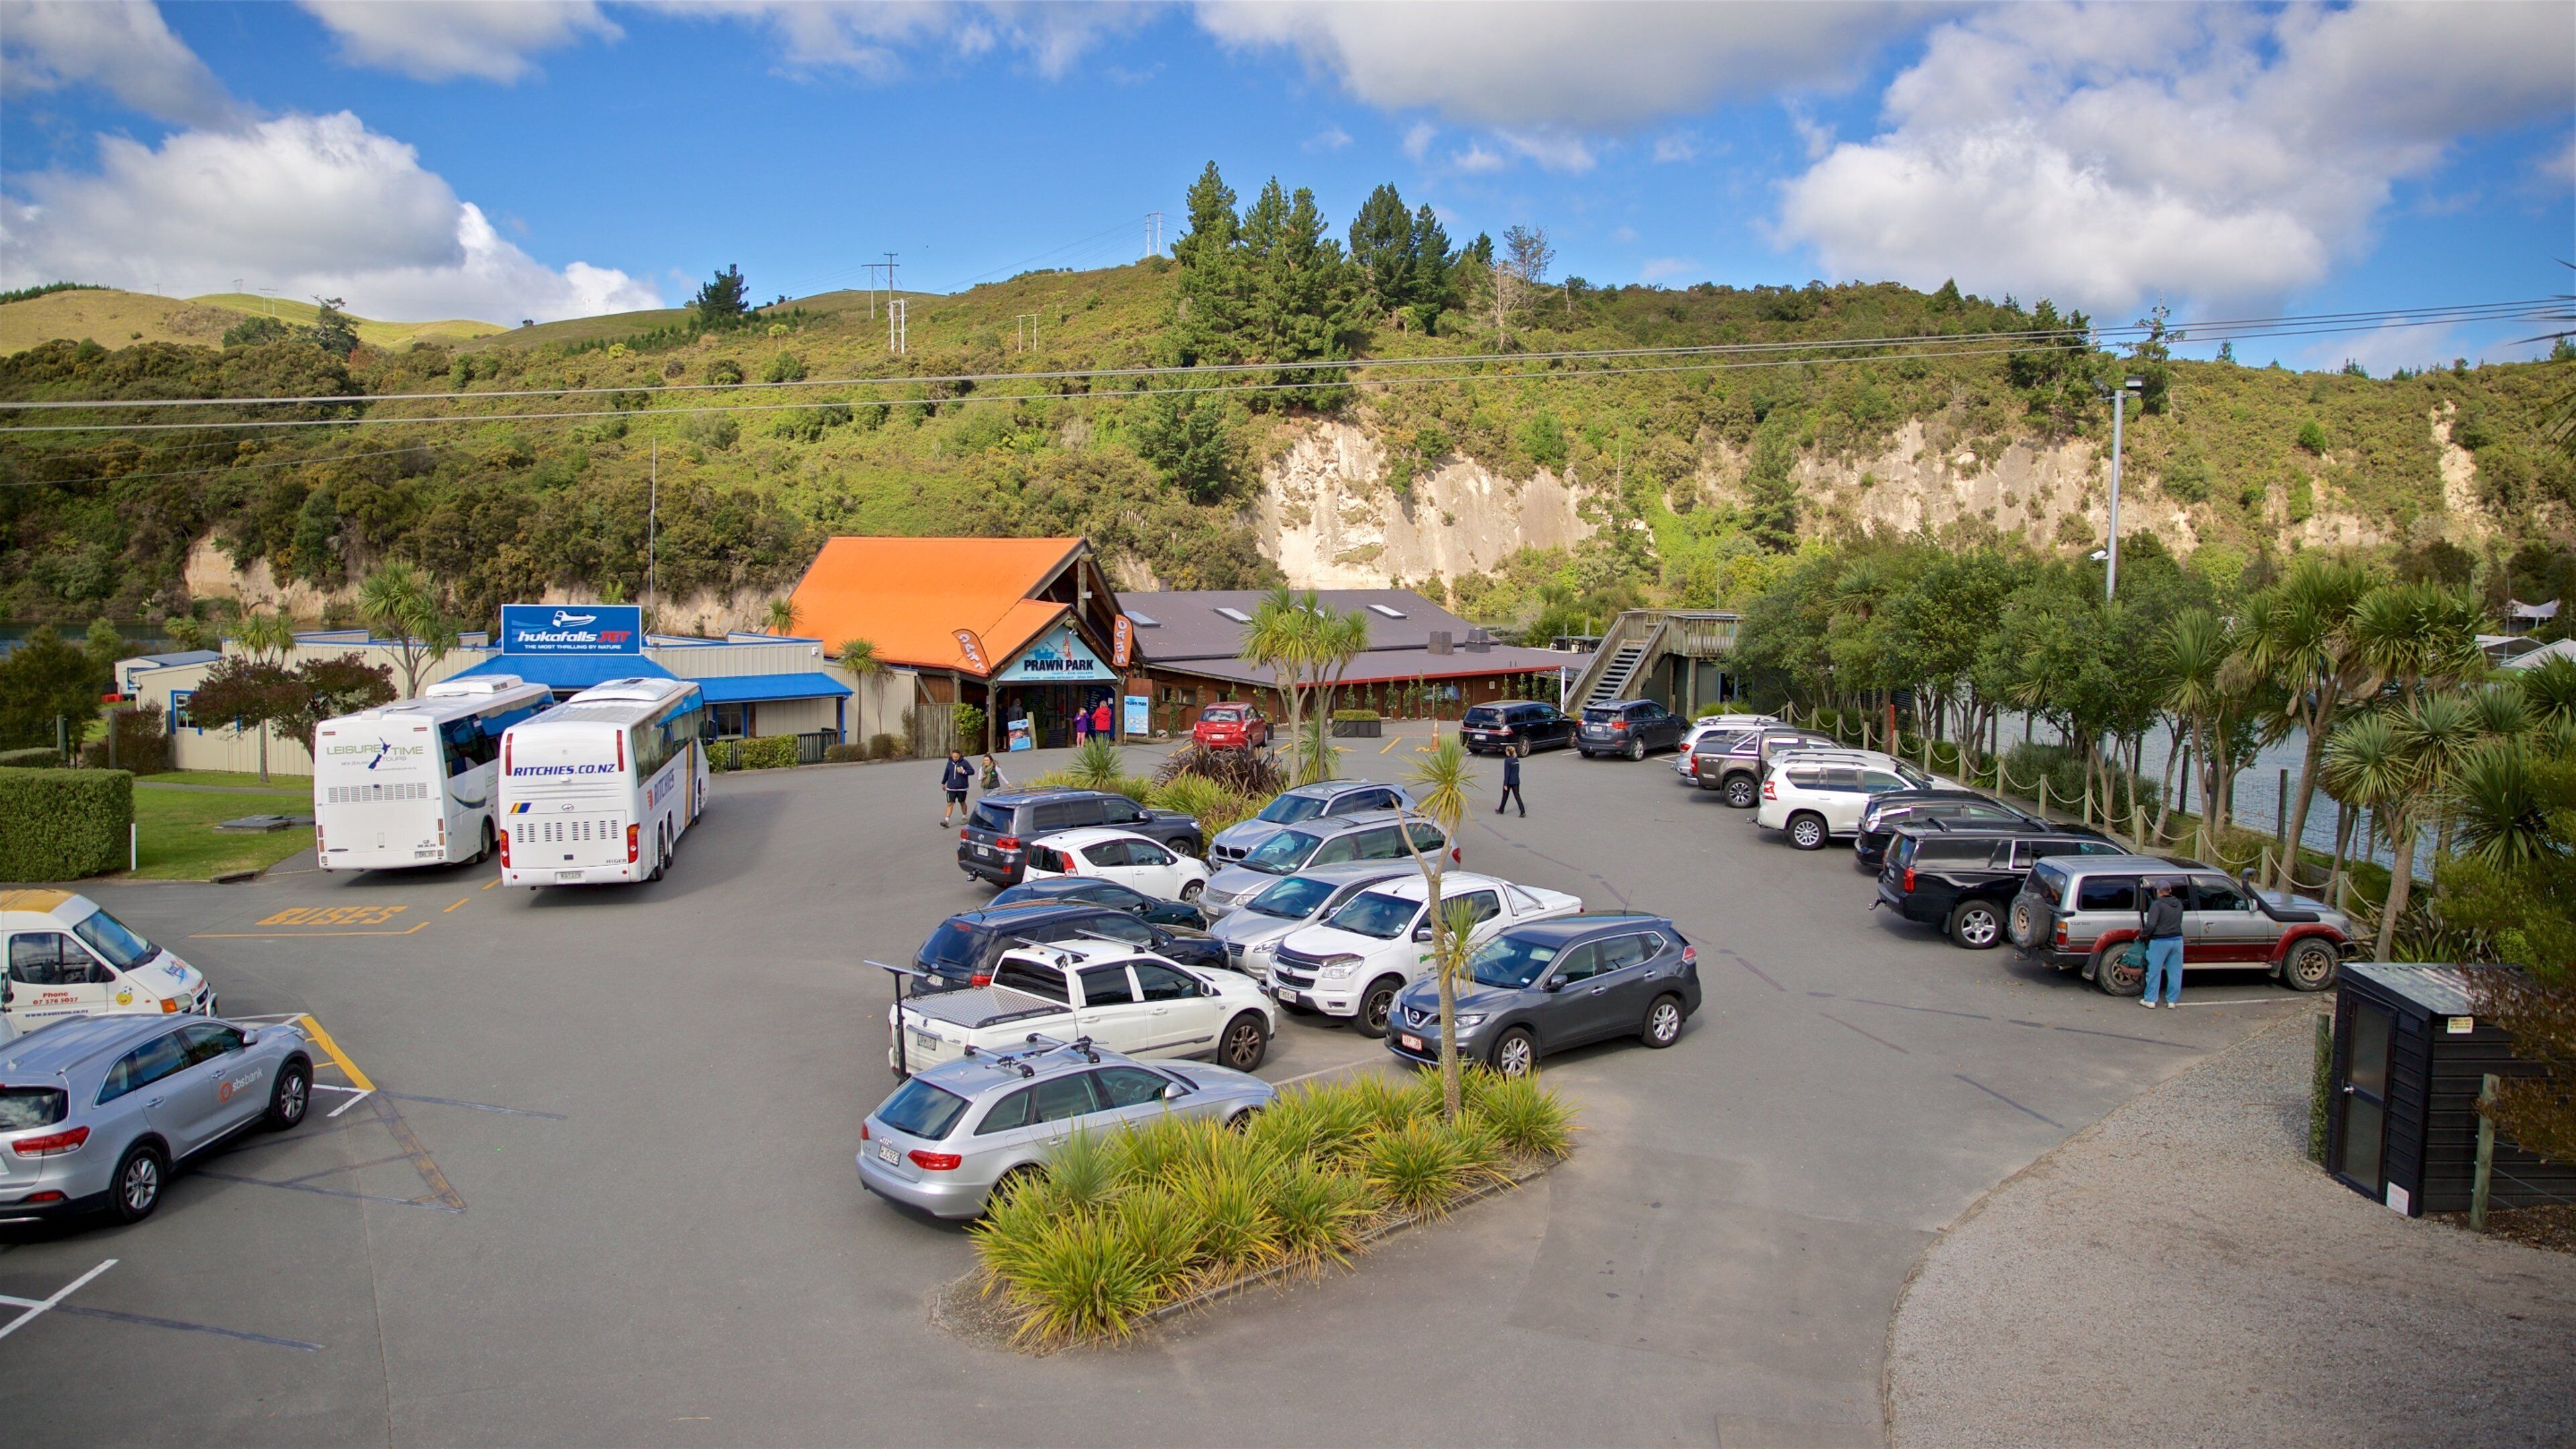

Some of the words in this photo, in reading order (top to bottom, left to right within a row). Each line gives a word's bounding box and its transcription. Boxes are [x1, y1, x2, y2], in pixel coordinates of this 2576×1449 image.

[518, 631, 597, 642] hukafalls
[596, 631, 631, 643] JET
[1024, 659, 1063, 671] PRAWN
[1065, 659, 1093, 671] PARK
[327, 744, 382, 755] LEISURE
[392, 746, 423, 755] TIME
[513, 763, 616, 776] RITCHIES.CO.NZ
[255, 905, 408, 925] BUSES
[232, 1067, 263, 1091] sbsbank
